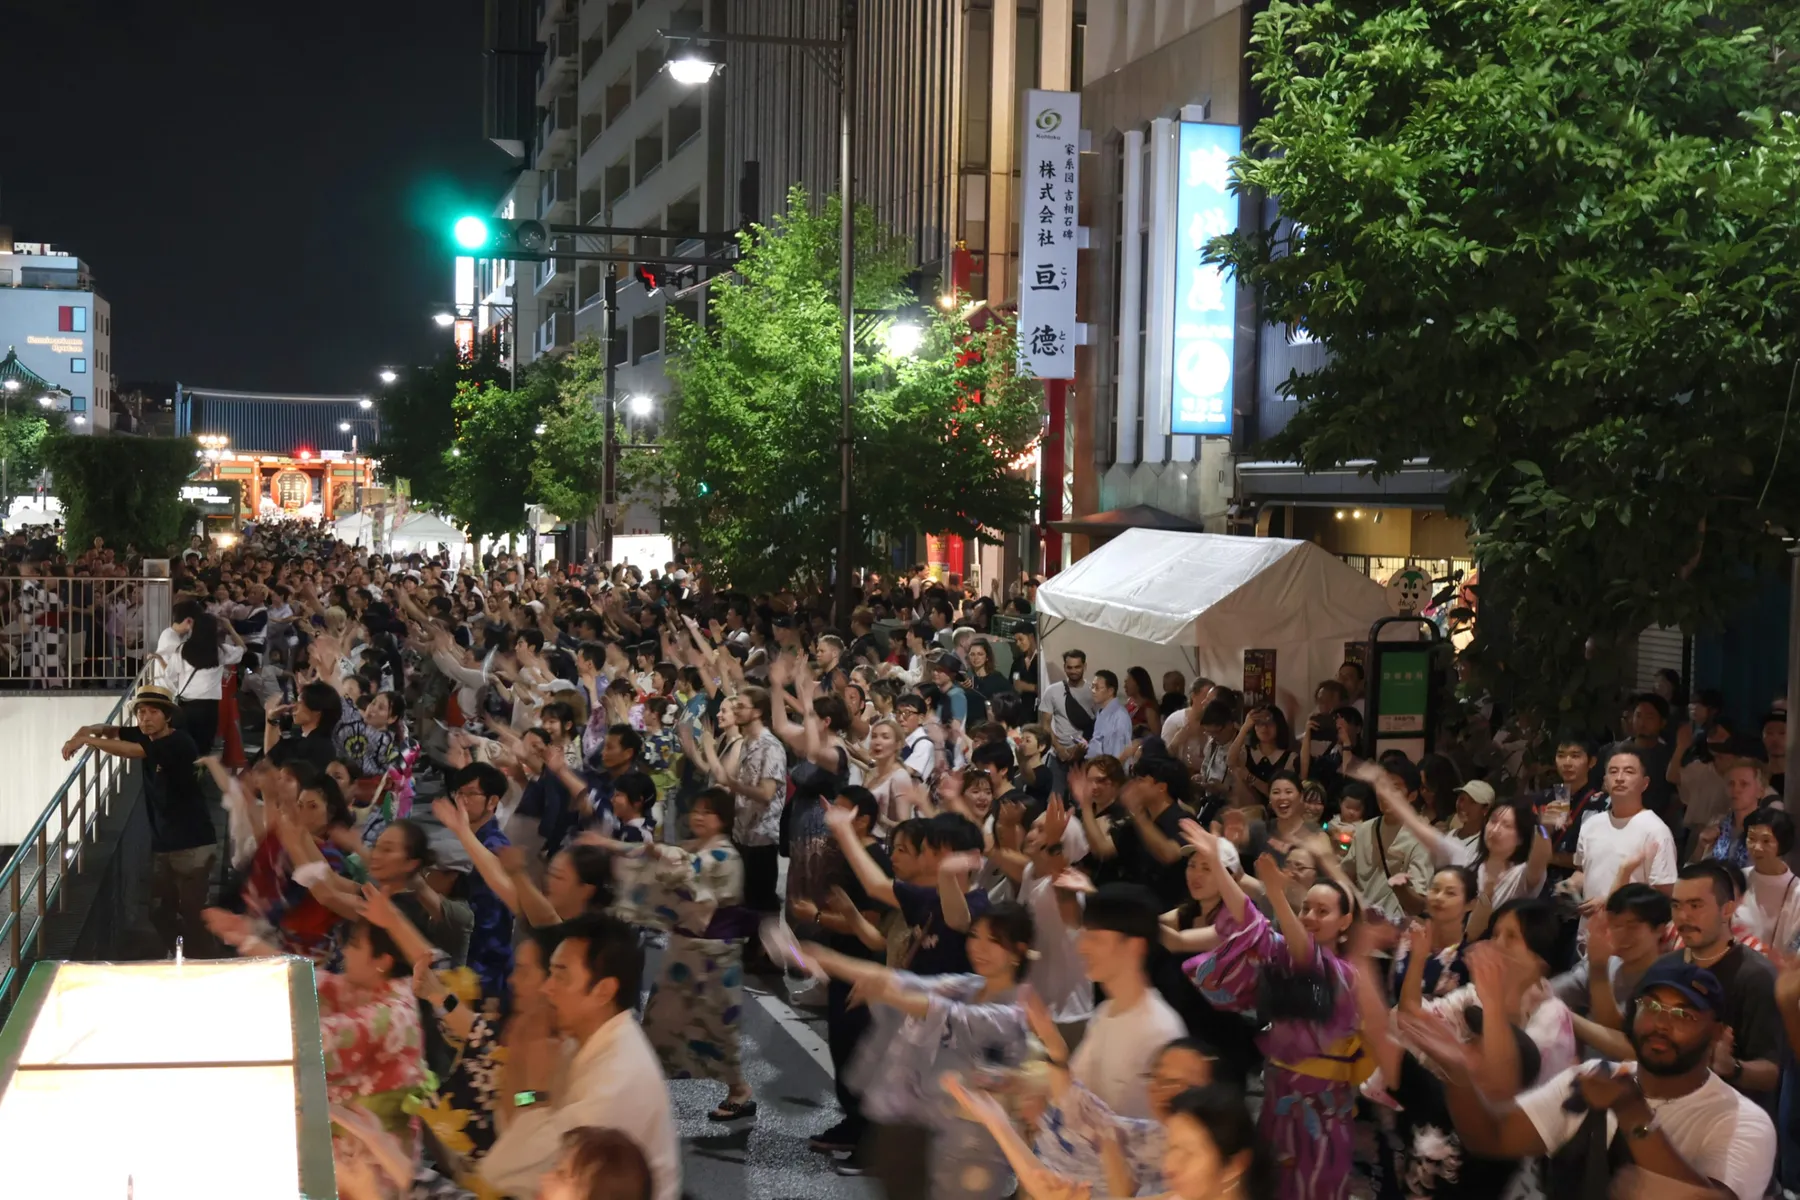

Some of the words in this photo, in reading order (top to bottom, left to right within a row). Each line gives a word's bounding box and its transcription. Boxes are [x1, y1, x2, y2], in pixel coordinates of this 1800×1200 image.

[1064, 143, 1075, 183] 家系図
[1037, 159, 1057, 247] 株式会社
[1062, 189, 1075, 240] 吉相石碑
[1060, 266, 1068, 289] こう
[1057, 330, 1066, 354] とく
